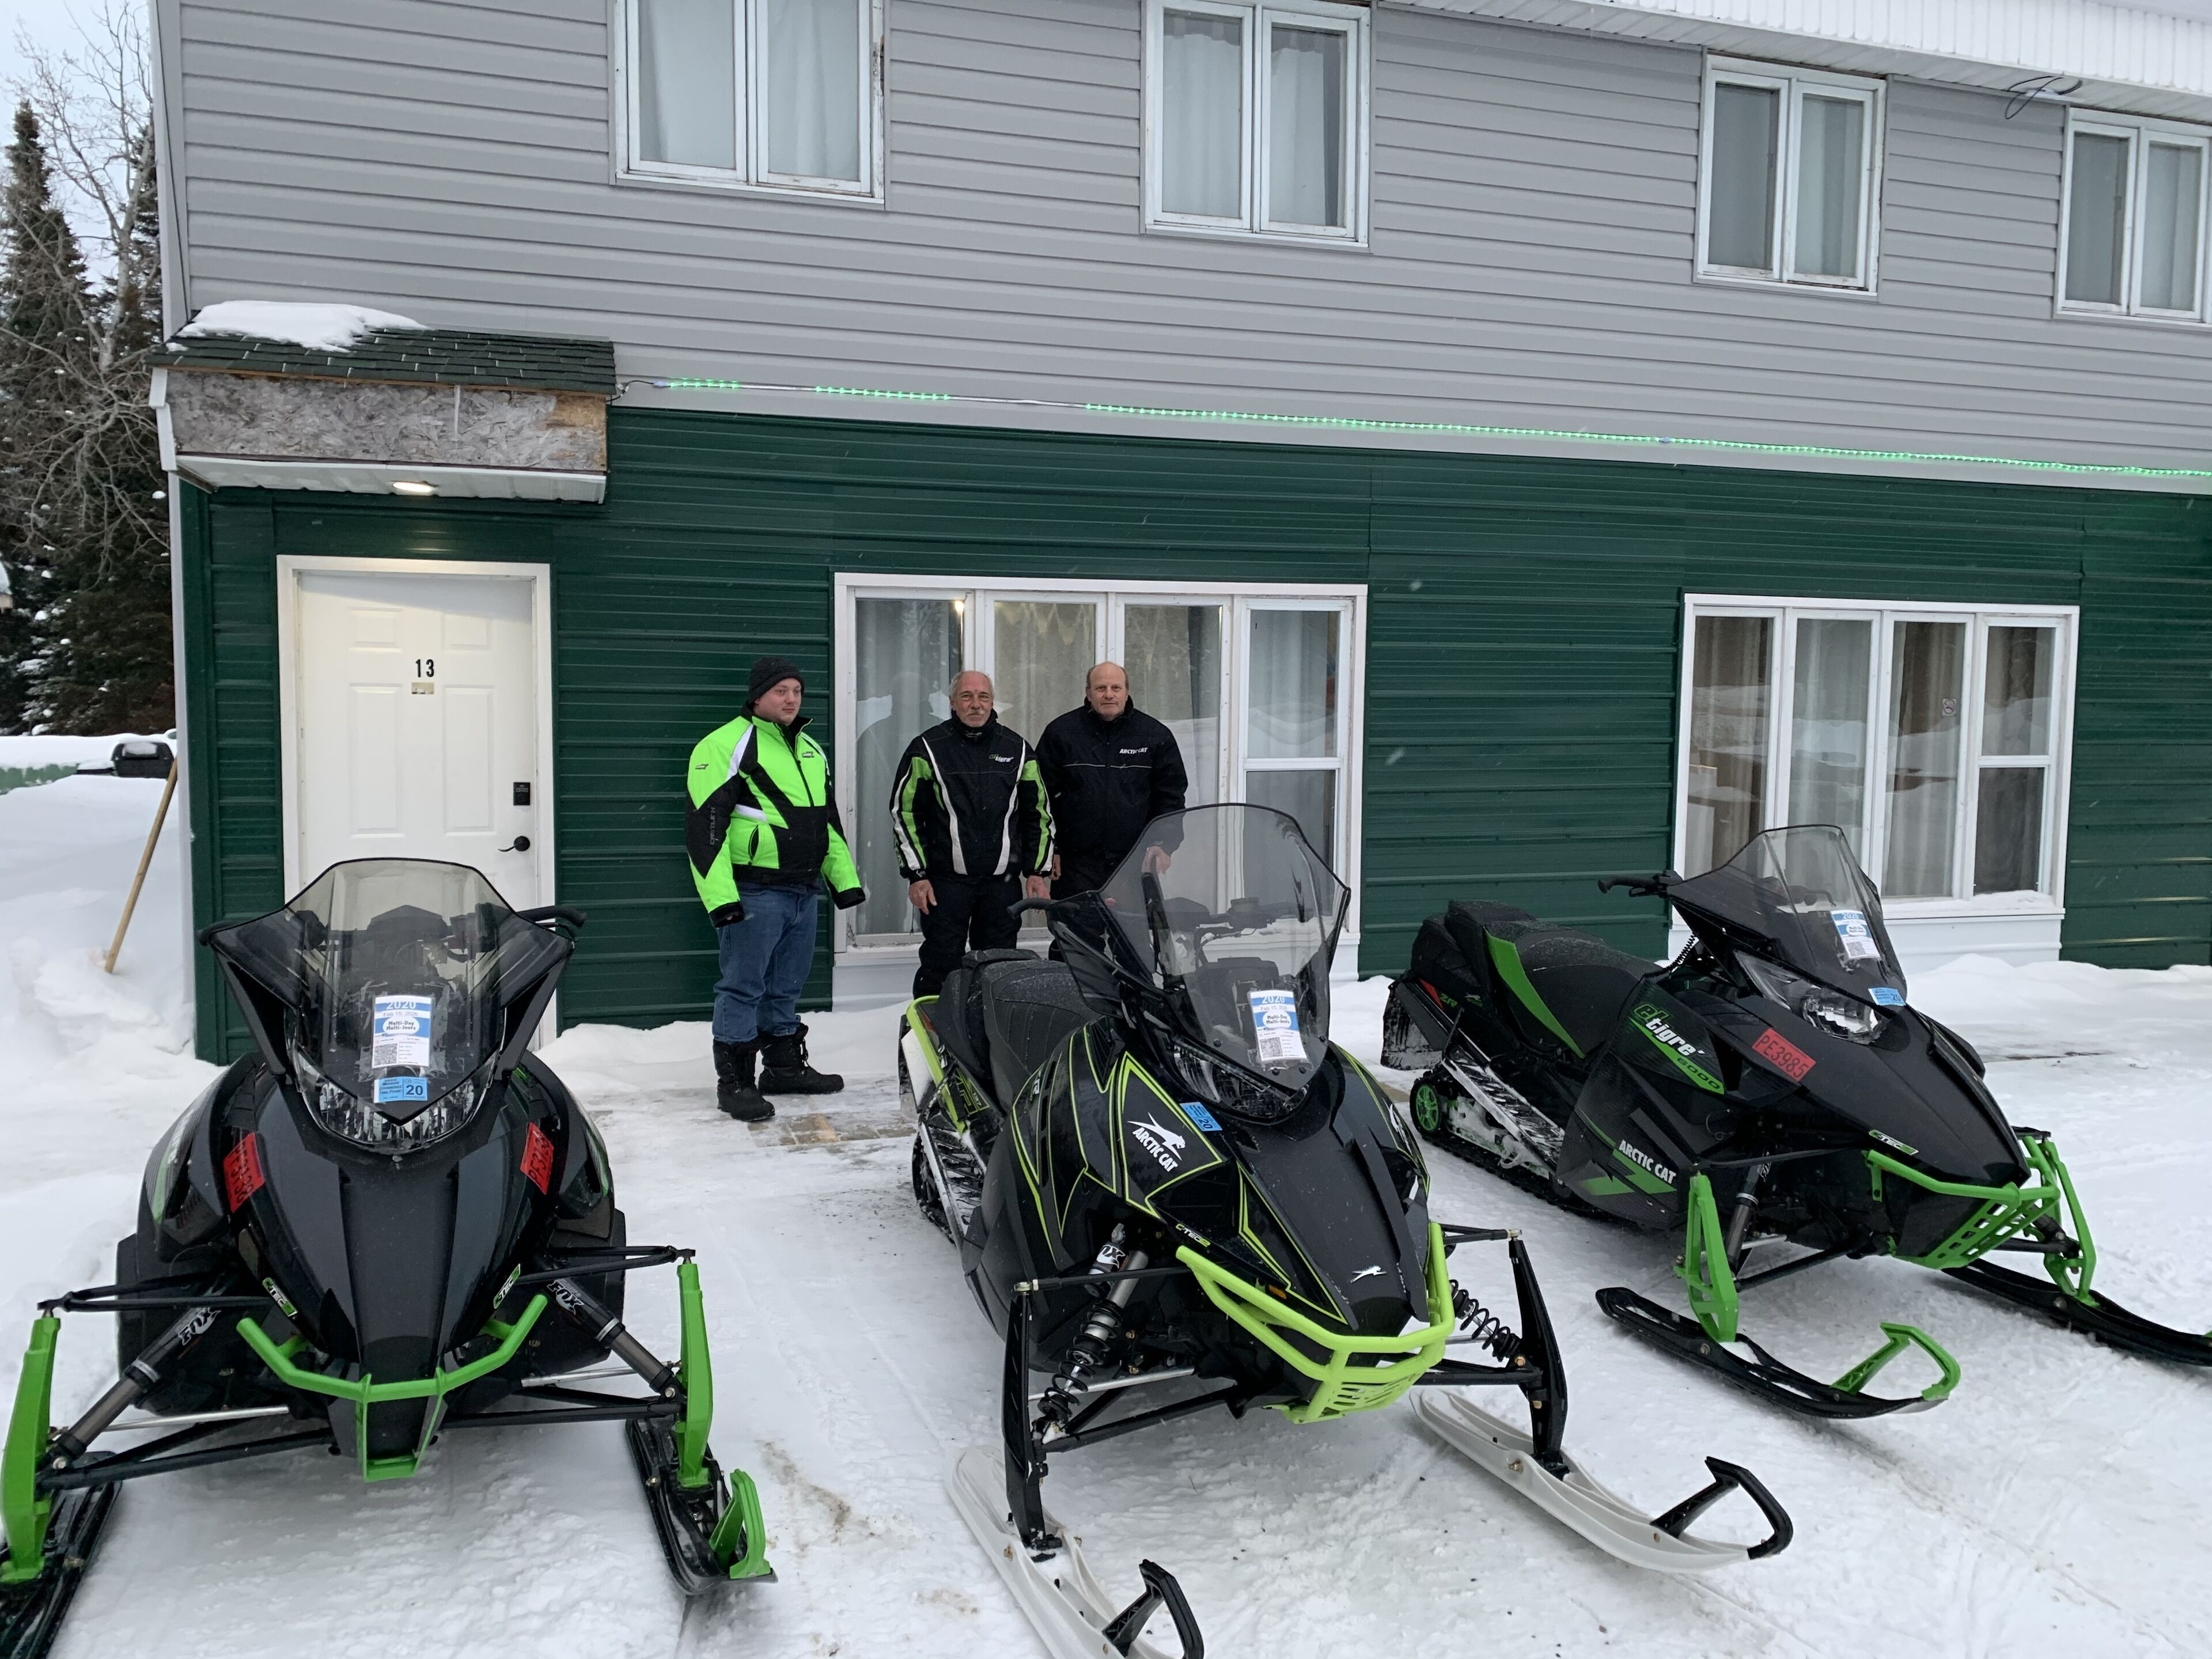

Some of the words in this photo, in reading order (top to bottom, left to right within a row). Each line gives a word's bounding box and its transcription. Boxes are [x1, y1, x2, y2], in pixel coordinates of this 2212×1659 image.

[415, 658, 435, 678] 13
[385, 1001, 416, 1010] 2020
[1262, 995, 1285, 1004] 2020
[1890, 993, 1901, 1002] 20
[1755, 1035, 1809, 1078] PE3985
[1677, 1058, 1720, 1089] 6000
[406, 1085, 423, 1096] 20
[1198, 1119, 1213, 1129] 20
[1132, 1127, 1164, 1158] ARCTIC
[1158, 1153, 1178, 1172] CAT
[1619, 1139, 1654, 1172] ARCTIC
[1654, 1164, 1677, 1184] CAT
[547, 1279, 584, 1310] FOX
